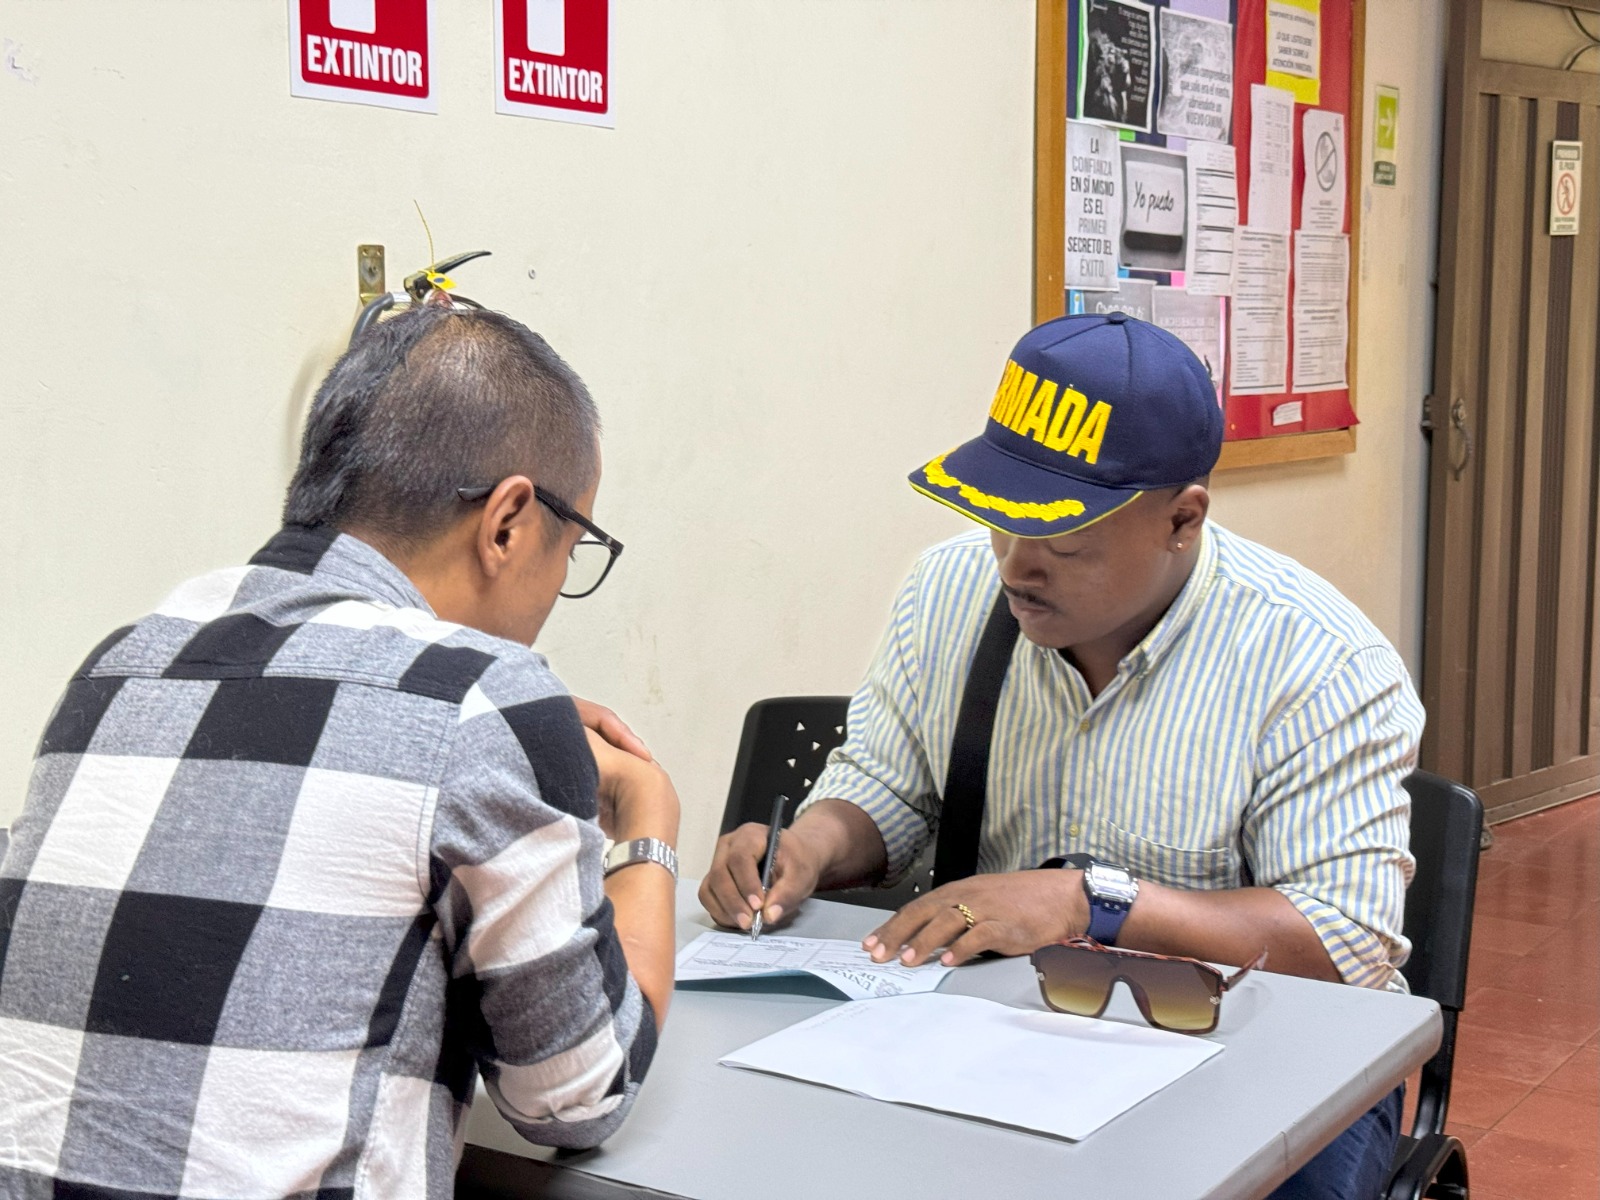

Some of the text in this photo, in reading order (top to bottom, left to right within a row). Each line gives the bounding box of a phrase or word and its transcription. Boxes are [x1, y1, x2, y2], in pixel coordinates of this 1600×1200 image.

[307, 33, 423, 88] EXTINTOR
[508, 57, 603, 104] EXTINTOR
[1090, 137, 1100, 154] LA
[1071, 156, 1113, 177] CONFIANZA
[1070, 176, 1082, 192] EN
[1083, 197, 1104, 215] ES EL
[1133, 180, 1175, 223] Yo puedo
[1078, 217, 1107, 236] PRIMER
[1067, 236, 1101, 255] SECRETO
[988, 358, 1113, 465] RMADA
